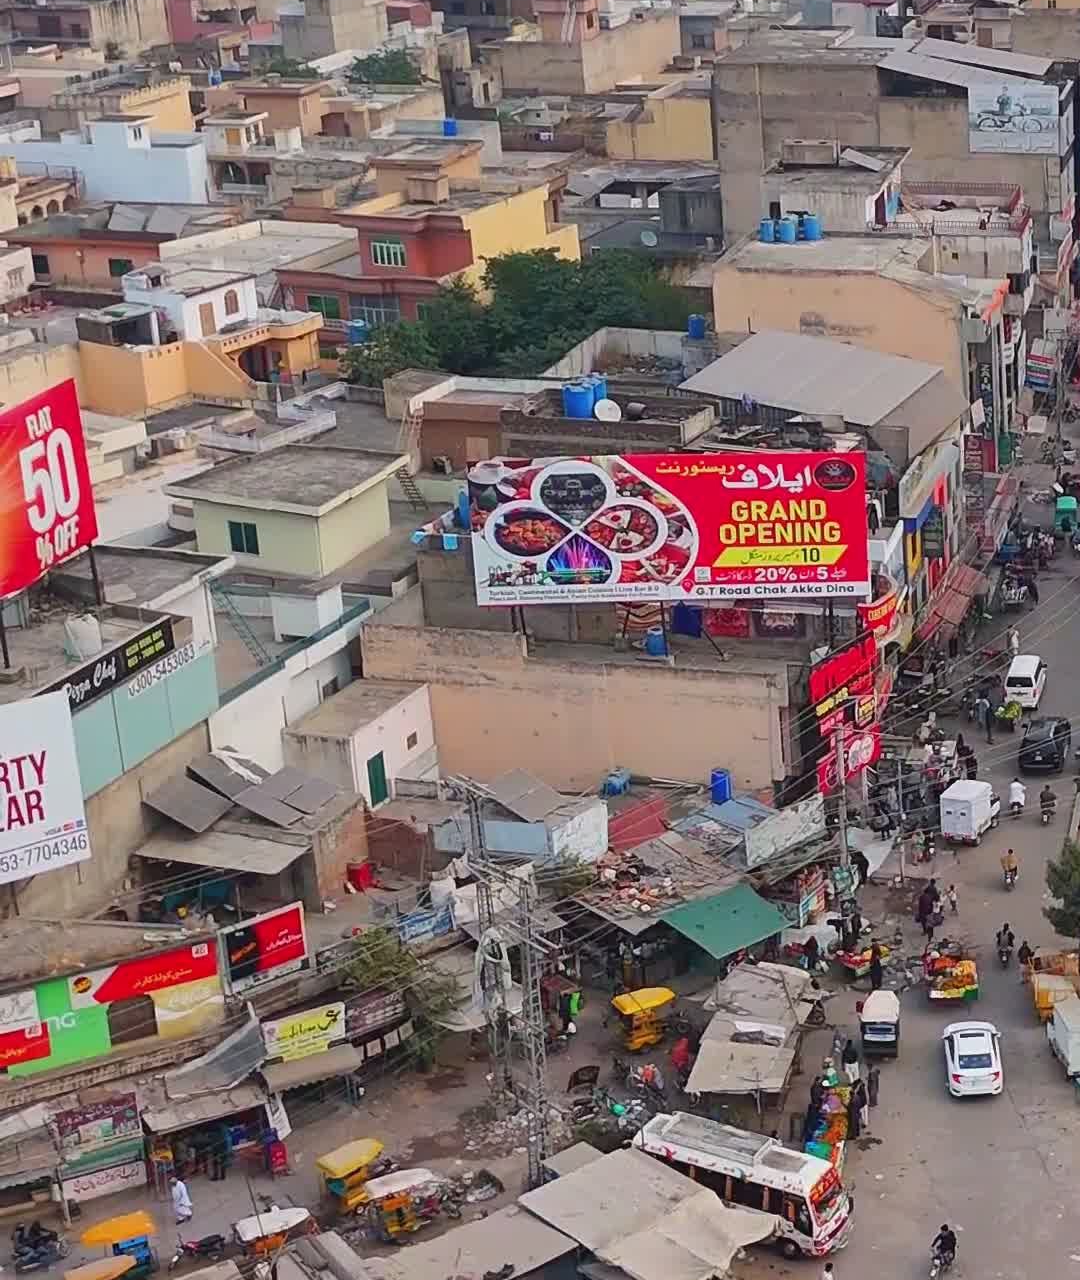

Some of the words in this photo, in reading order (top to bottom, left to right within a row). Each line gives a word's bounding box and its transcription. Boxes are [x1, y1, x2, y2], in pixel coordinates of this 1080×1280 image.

[25, 405, 53, 441] FLAT
[19, 427, 80, 534] 50
[731, 499, 827, 522] GRAND
[54, 514, 80, 556] OFF
[719, 522, 841, 545] OPENING
[801, 547, 820, 563] 10
[755, 567, 798, 582] 20%
[816, 566, 828, 580] 5
[696, 585, 714, 596] G.T
[719, 584, 751, 596] Road
[754, 584, 787, 595] Chak
[791, 583, 822, 594] Akka
[827, 582, 855, 593] Dina
[93, 656, 117, 688] Chef
[0, 789, 46, 832] AR
